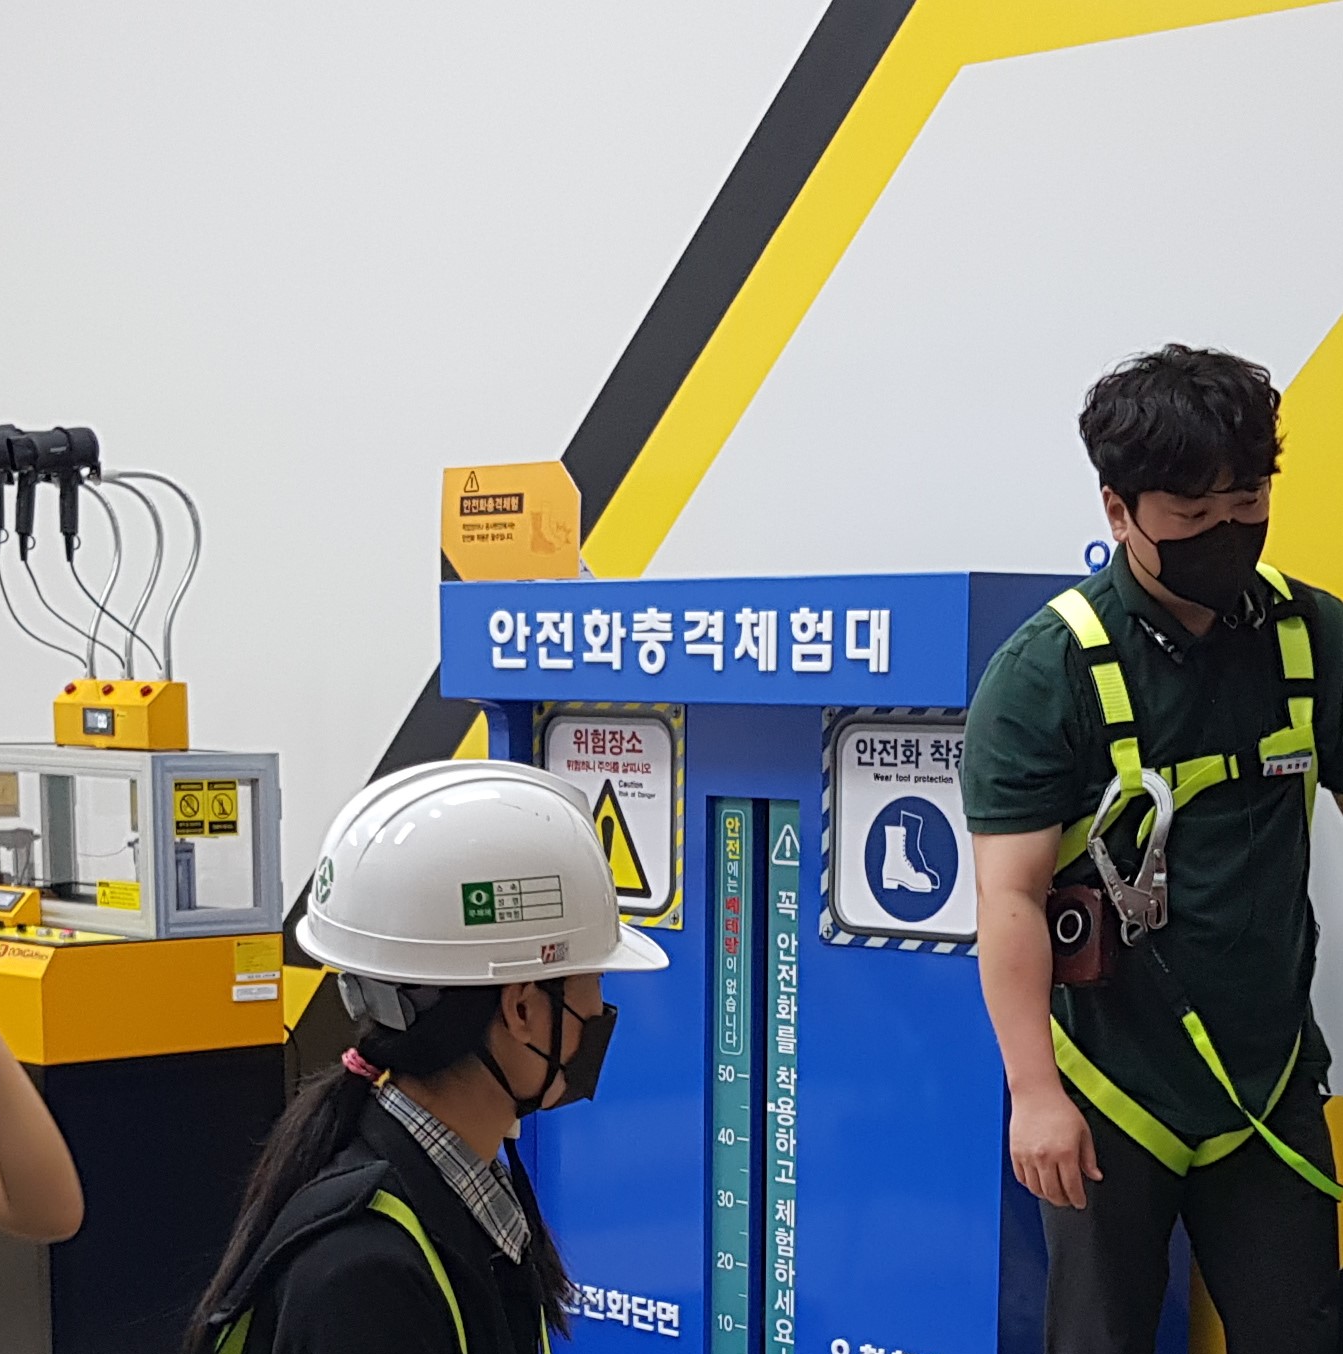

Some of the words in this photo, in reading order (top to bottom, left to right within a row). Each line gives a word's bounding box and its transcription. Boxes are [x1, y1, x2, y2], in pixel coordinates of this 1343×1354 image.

[489, 606, 890, 675] 안전화충격체험대
[573, 728, 643, 755] 위험장소
[856, 738, 922, 769] 안전화
[873, 773, 892, 781] Wear
[914, 775, 953, 784] protection
[725, 817, 741, 893] 안전에는
[776, 891, 798, 920] 꼭
[776, 933, 798, 1055] 안전화를
[724, 978, 738, 1047] 없습니다
[718, 1065, 734, 1083] 50
[717, 1128, 735, 1146] 40
[775, 1066, 797, 1184] 착용하고
[717, 1191, 734, 1208] 30
[717, 1253, 734, 1270] 20
[717, 1314, 733, 1331] 10
